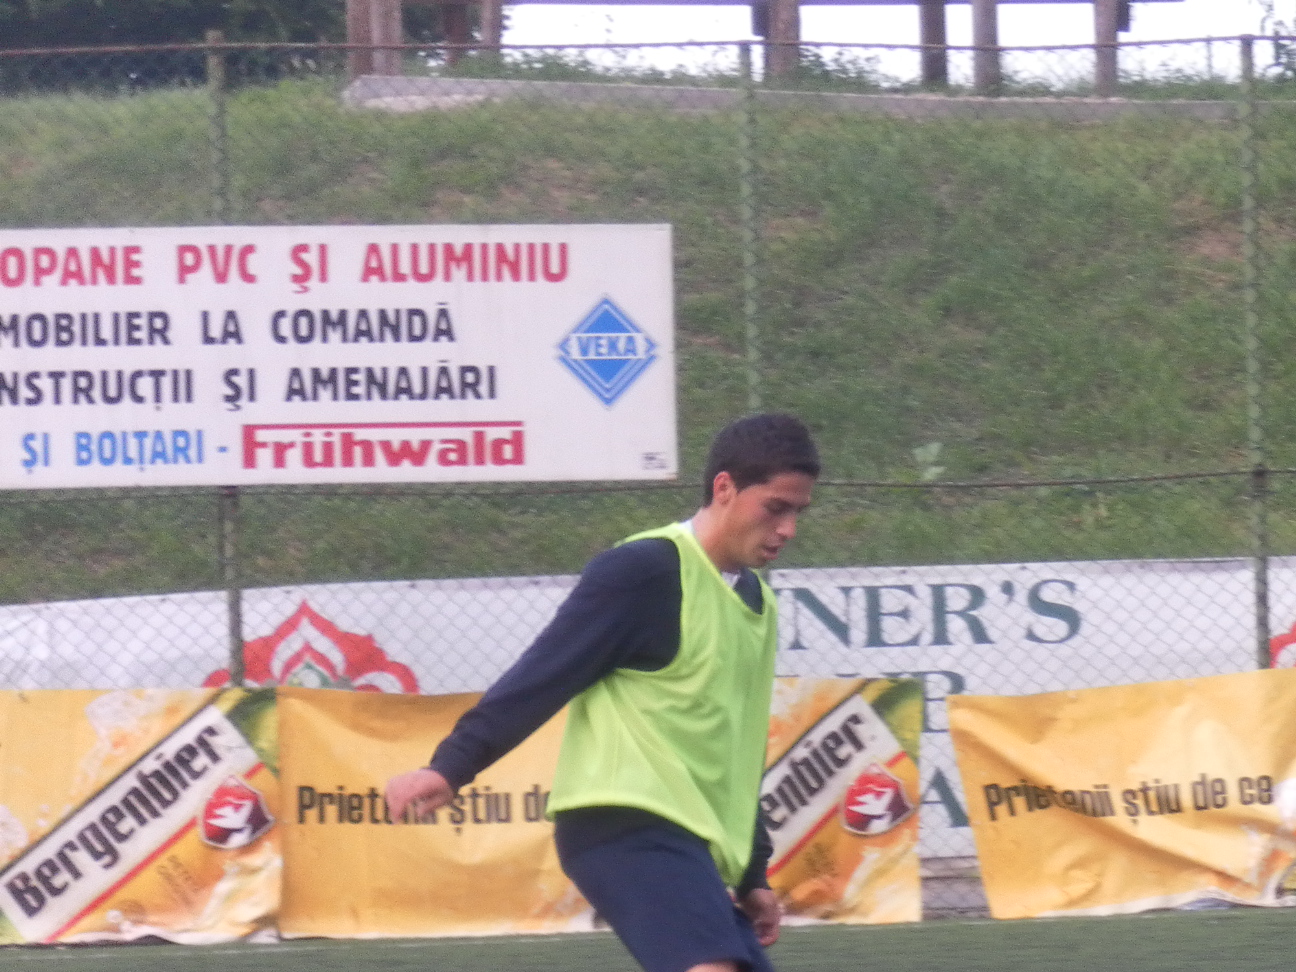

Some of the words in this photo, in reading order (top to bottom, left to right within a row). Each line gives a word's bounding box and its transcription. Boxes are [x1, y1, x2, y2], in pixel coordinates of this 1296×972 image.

[0, 245, 143, 287] OPANE
[176, 243, 257, 285] PVC
[360, 241, 568, 283] ALUMINIU
[0, 311, 171, 348] MOBILIER
[201, 310, 243, 345] LA
[271, 301, 456, 346] COMANDĂ
[577, 335, 638, 357] VEKA
[284, 359, 497, 402] AMENAJĂRI
[242, 421, 525, 469] Frühwald
[775, 578, 1082, 650] NER'S
[760, 712, 866, 830] enbier
[297, 784, 437, 825] Prietn
[983, 778, 1116, 821] Prietenii
[1190, 773, 1227, 811] de
[1238, 774, 1273, 806] ce
[4, 725, 222, 918] Bergenbier
